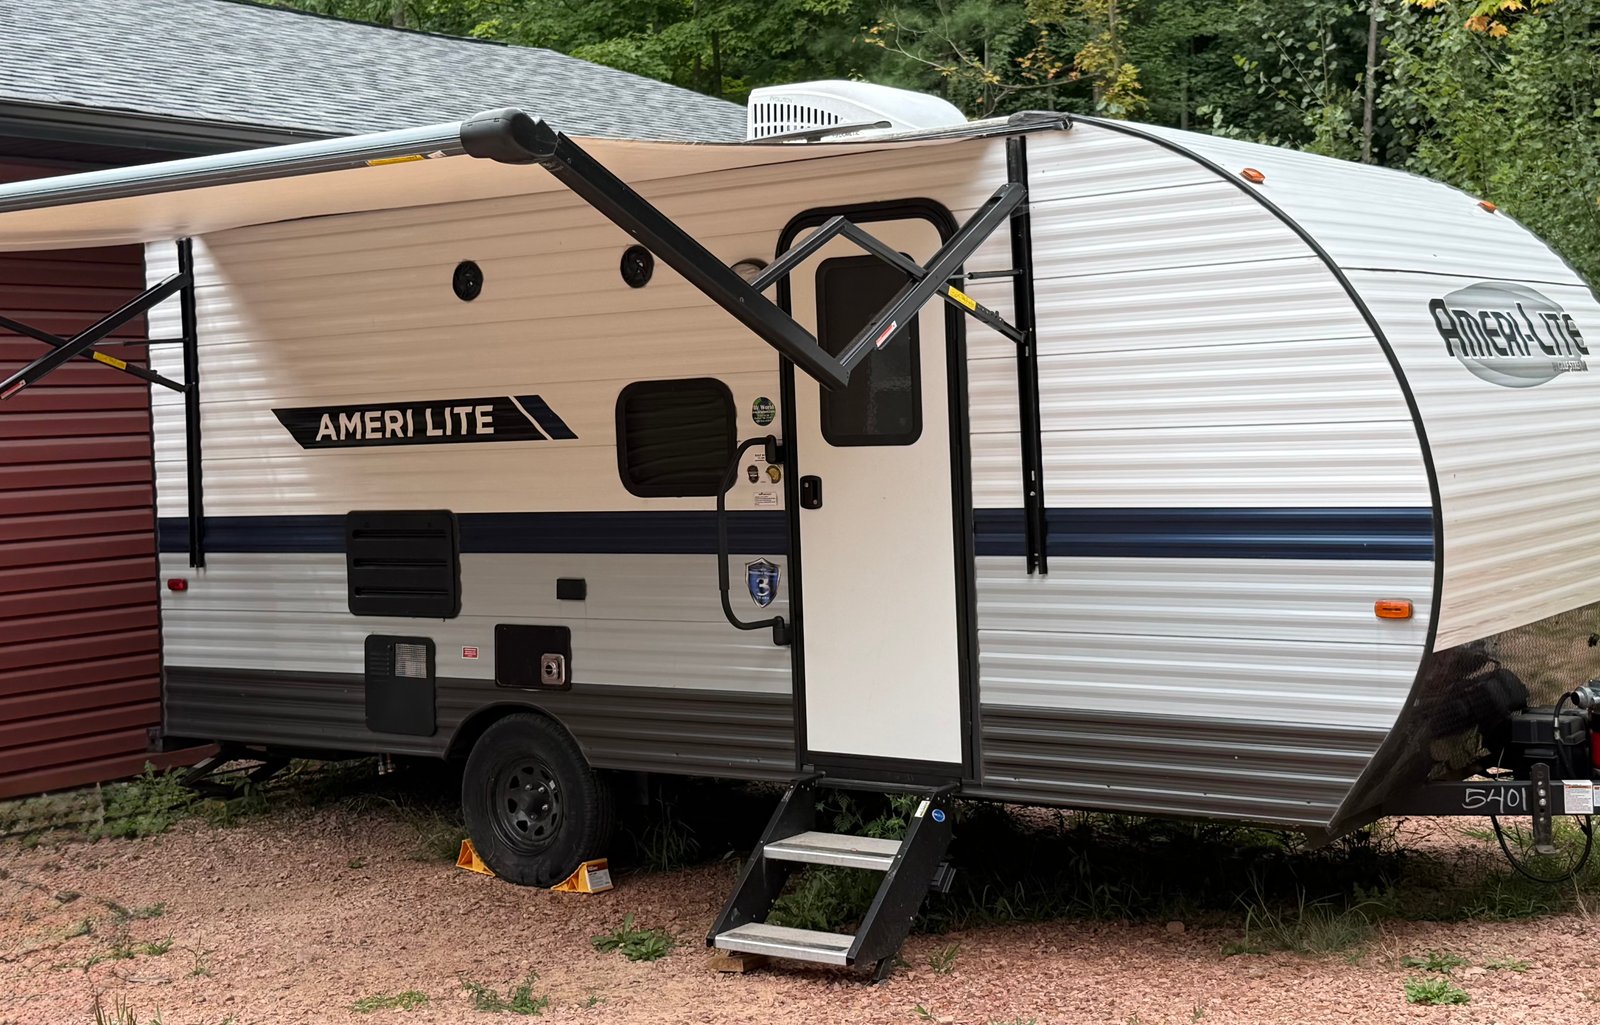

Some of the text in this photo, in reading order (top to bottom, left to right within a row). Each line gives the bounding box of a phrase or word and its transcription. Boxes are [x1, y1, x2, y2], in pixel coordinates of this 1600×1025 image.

[315, 405, 494, 441] AMERI LITE
[1461, 787, 1527, 814] 5401
